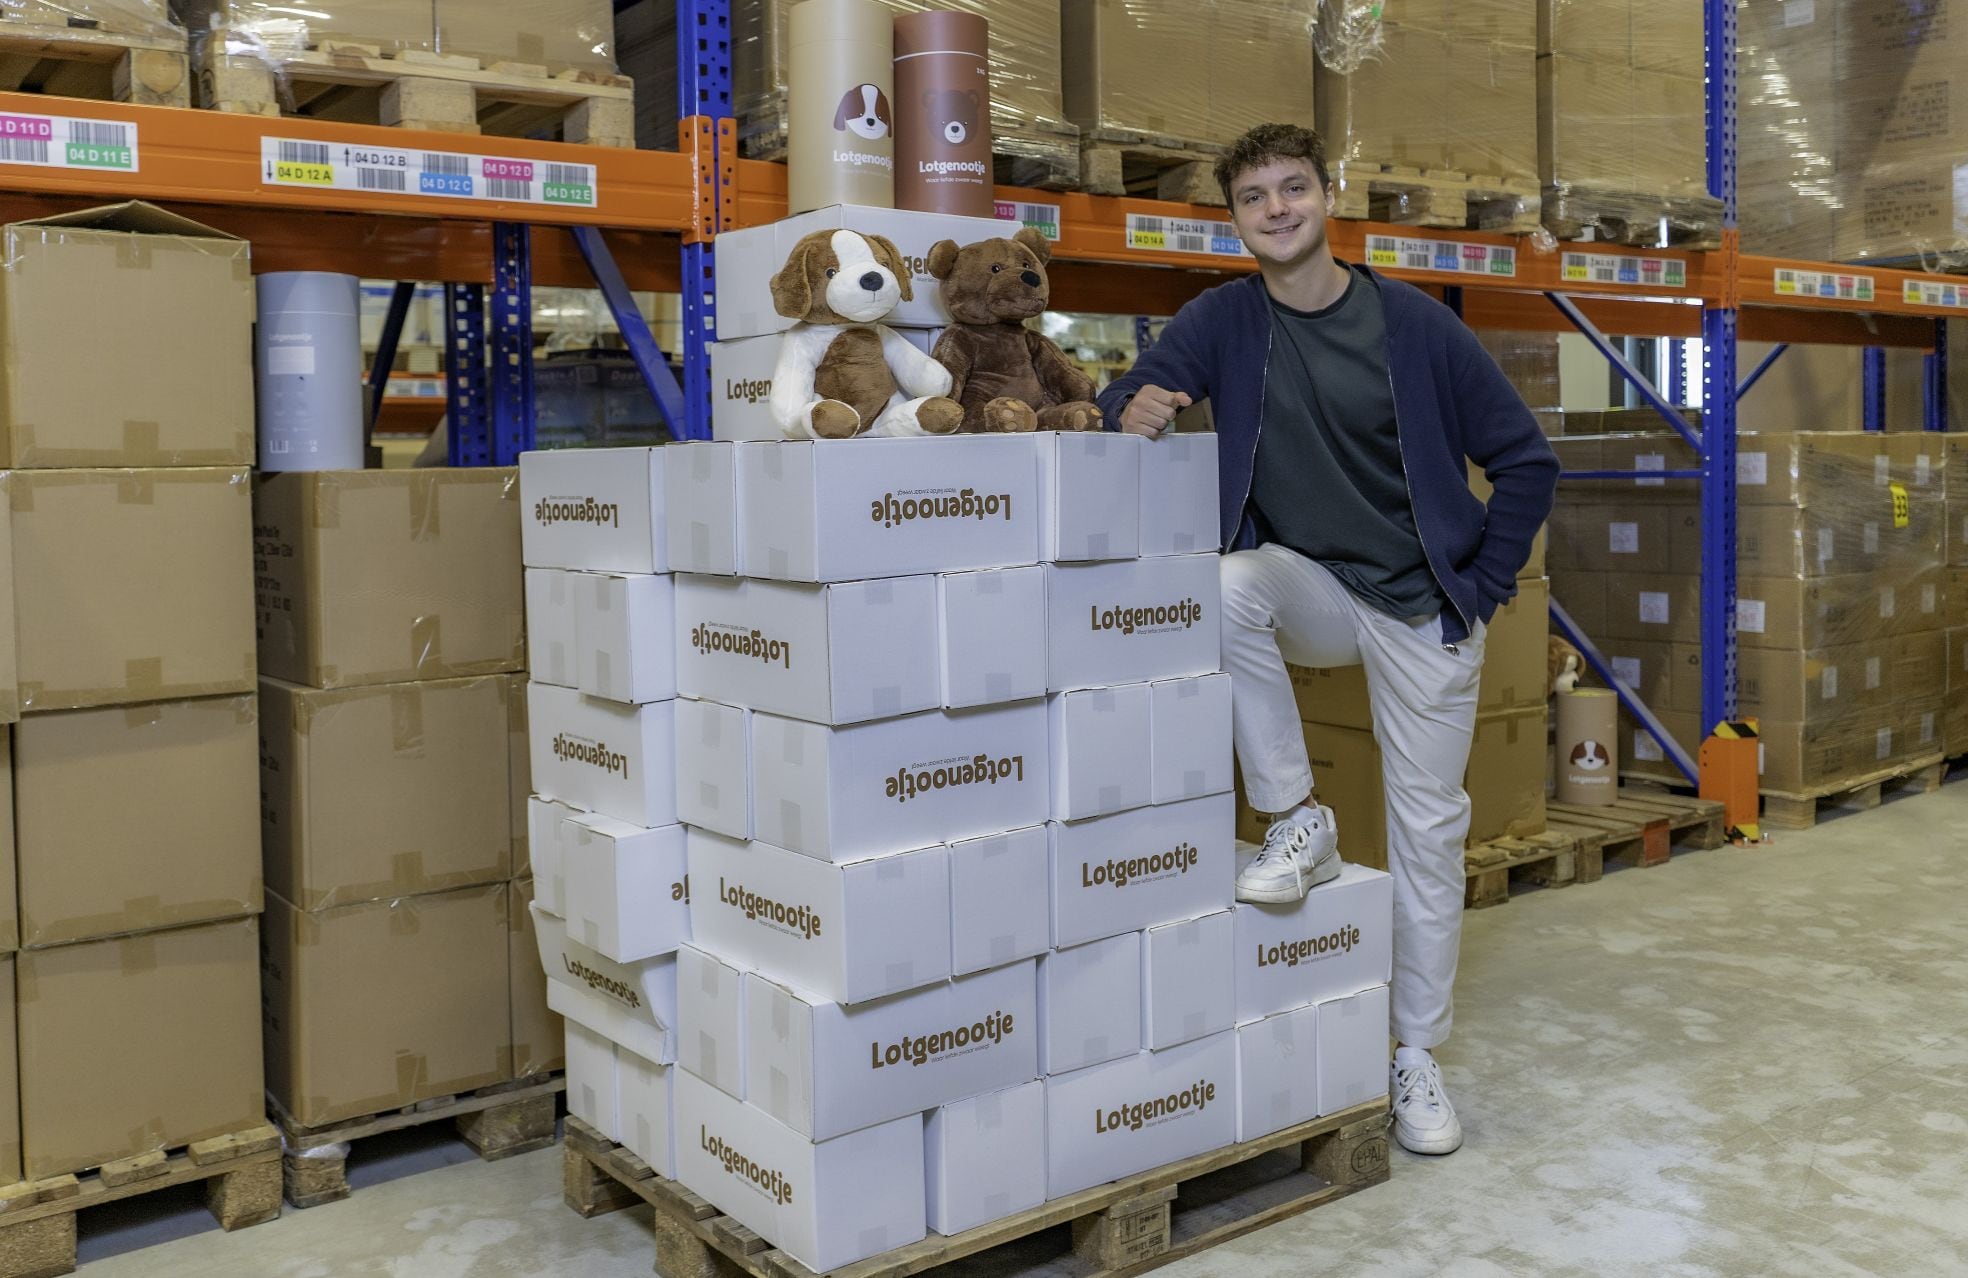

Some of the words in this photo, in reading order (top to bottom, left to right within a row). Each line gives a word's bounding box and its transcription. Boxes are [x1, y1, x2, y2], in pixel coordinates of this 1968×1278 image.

[69, 148, 85, 160] 04
[88, 150, 98, 161] D
[102, 151, 116, 162] 11
[121, 152, 130, 163] E
[278, 166, 291, 177] 04
[295, 168, 303, 178] D
[308, 169, 319, 180] 12
[323, 170, 332, 180] A
[355, 153, 368, 163] 04
[372, 154, 379, 164] D
[383, 155, 394, 165] 12
[398, 156, 406, 166] B
[484, 164, 496, 174] 04
[499, 164, 508, 175] D
[510, 165, 520, 175] 12
[524, 166, 531, 176] D
[919, 160, 985, 175] Lotgenootje
[422, 178, 434, 188] 04
[437, 179, 445, 189] D
[449, 180, 460, 190] 12
[462, 181, 470, 191] C
[546, 187, 557, 197] 04
[560, 188, 568, 198] D
[571, 189, 581, 199] 12
[584, 190, 591, 200] E
[535, 497, 618, 528] Lotgenootje
[872, 488, 1010, 528] Lotgenootje
[1092, 598, 1201, 635] Lotgenootje
[692, 623, 789, 669] Lotgenootje
[553, 733, 627, 780] Lotgenootje
[886, 754, 1022, 802] Lotgenootje
[1083, 842, 1197, 888] Lotgenootje
[720, 877, 820, 940] Lotgenootje
[1258, 924, 1359, 967] Lotgenootje
[872, 1011, 1013, 1069] Lotgenootje
[1096, 1080, 1215, 1134] Lotgenootje
[702, 1124, 792, 1205] Lotgenootje
